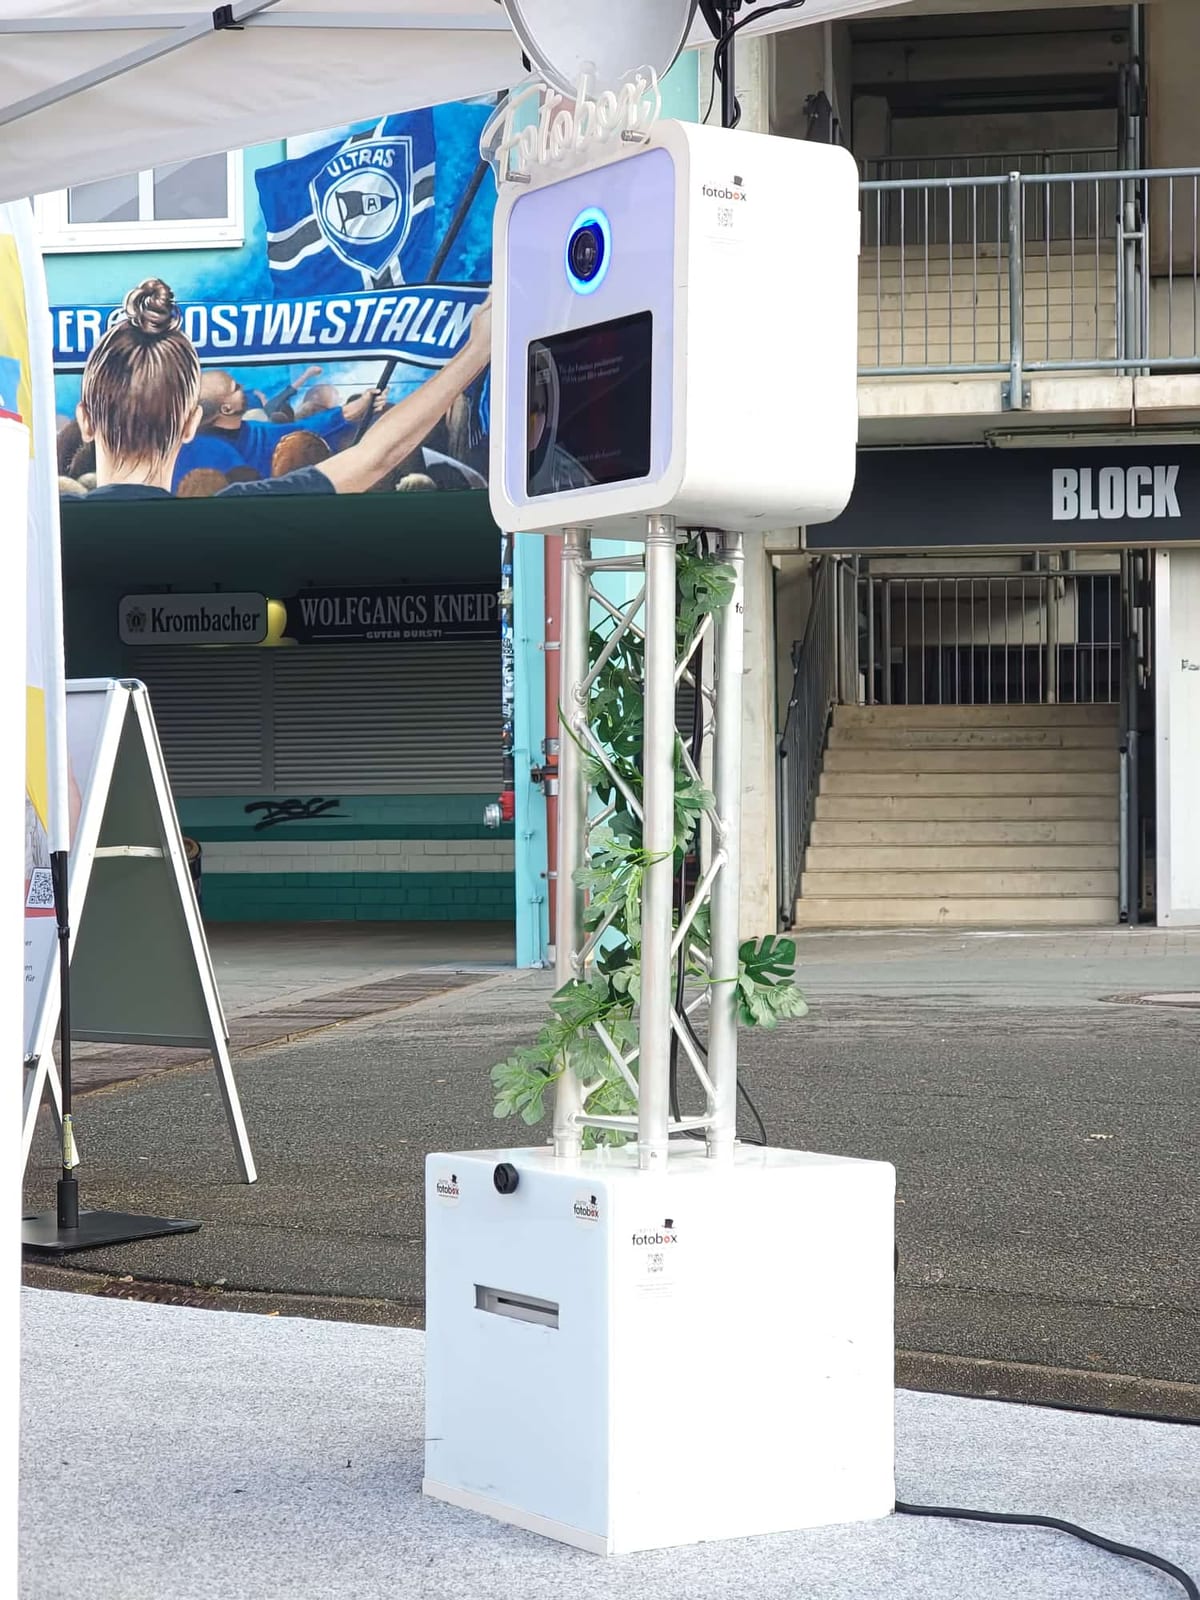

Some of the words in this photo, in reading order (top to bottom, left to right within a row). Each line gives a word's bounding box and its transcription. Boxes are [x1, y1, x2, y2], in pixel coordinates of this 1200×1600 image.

[326, 148, 396, 178] ULTRAS
[367, 198, 378, 211] A
[702, 184, 747, 202] fotobox
[51, 309, 101, 353] ER
[185, 296, 482, 348] OSTWESTFALEN
[1052, 465, 1181, 520] BLOCK
[151, 606, 260, 633] Krombacher
[300, 595, 428, 626] WOLFGANGS
[433, 593, 502, 623] KNEIP
[574, 1203, 599, 1217] fotobox
[632, 1232, 678, 1246] fotobox
